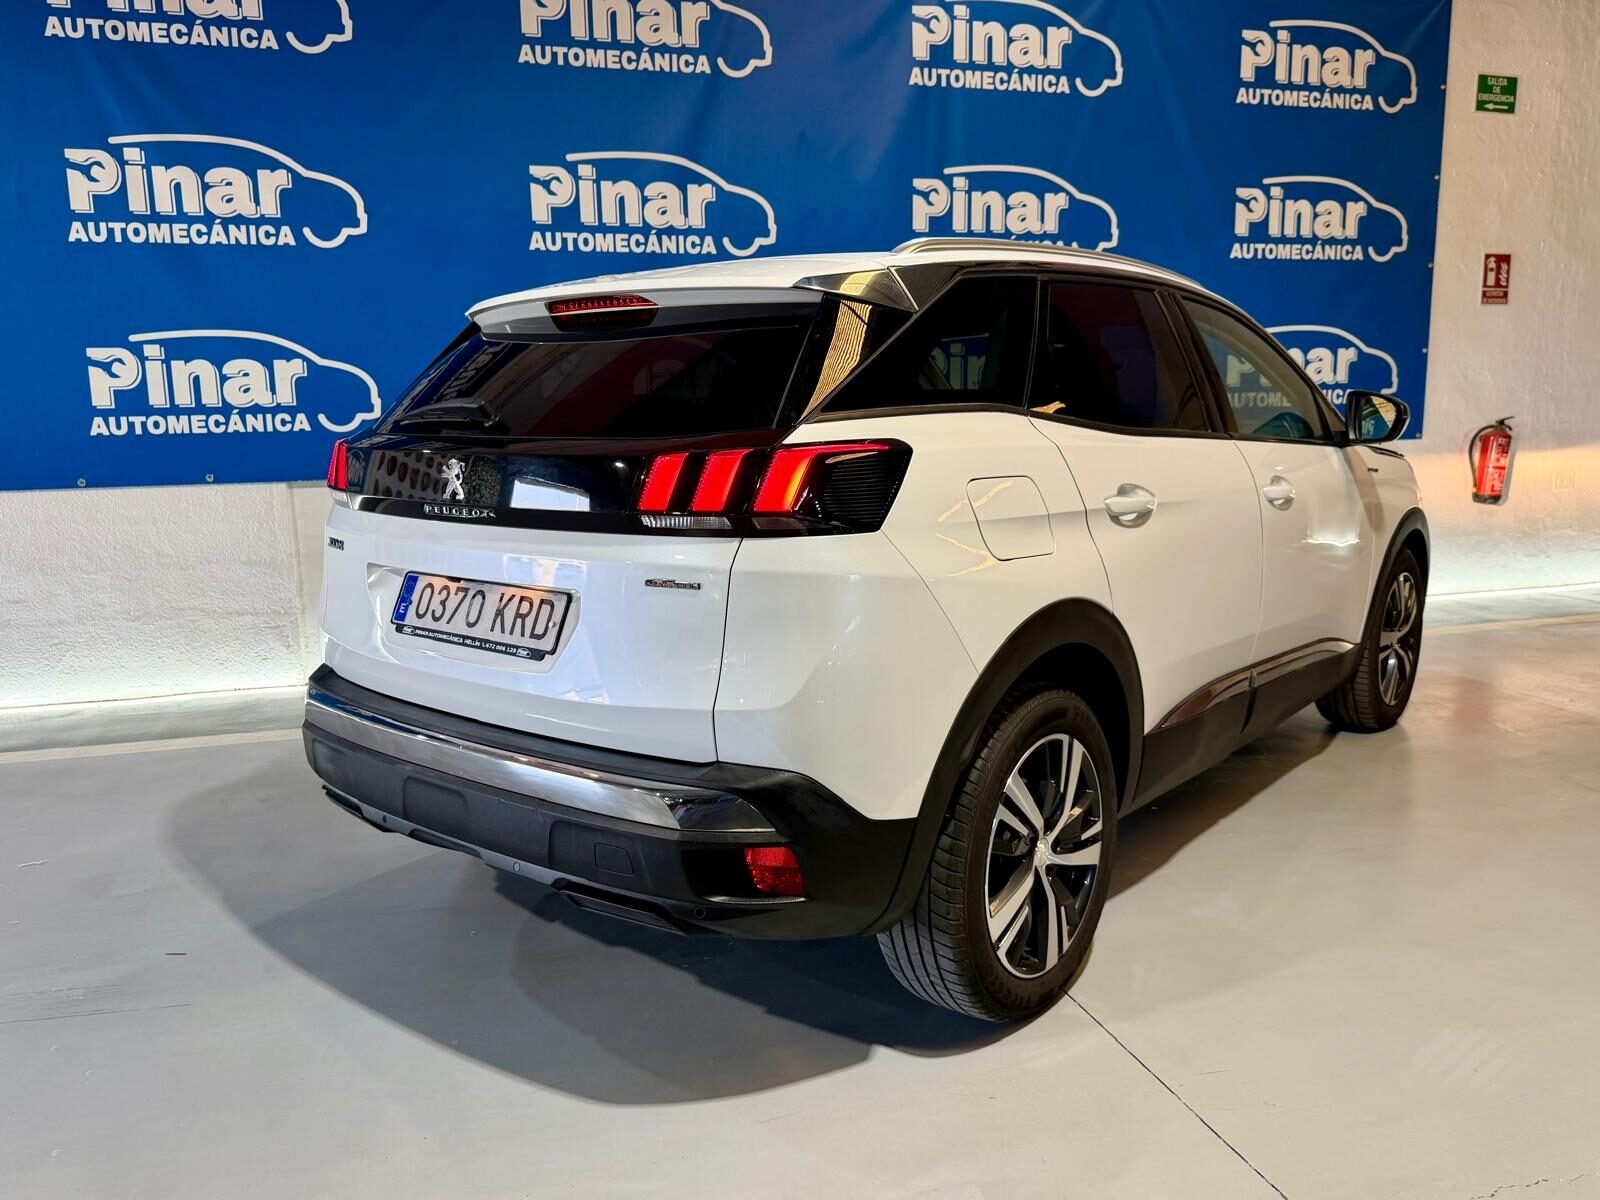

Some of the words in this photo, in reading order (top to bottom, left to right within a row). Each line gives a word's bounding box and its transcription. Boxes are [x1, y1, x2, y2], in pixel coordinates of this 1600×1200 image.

[44, 15, 279, 50] AUTOMECÁNICA
[520, 0, 711, 48] Pinar
[911, 5, 1073, 69] Pinar
[518, 43, 711, 74] AUTOMECÁNICA
[909, 67, 1070, 94] AUTOMECÁNICA
[1240, 29, 1376, 88] Pinar
[1236, 87, 1374, 110] AUTOMECÁNICA
[63, 147, 293, 219] Pinar
[528, 164, 716, 229] Pinar
[912, 176, 1069, 234] Pinar
[68, 219, 297, 246] AUTOMECÁNICA
[1234, 186, 1367, 239] Pinar
[529, 230, 717, 255] AUTOMECÁNICA
[1229, 240, 1364, 261] AUTOMECÁNICA
[86, 344, 308, 409] Pinar
[90, 409, 312, 436] AUTOMECÁNICA
[415, 582, 486, 629] 0370
[490, 592, 555, 641] KRD
